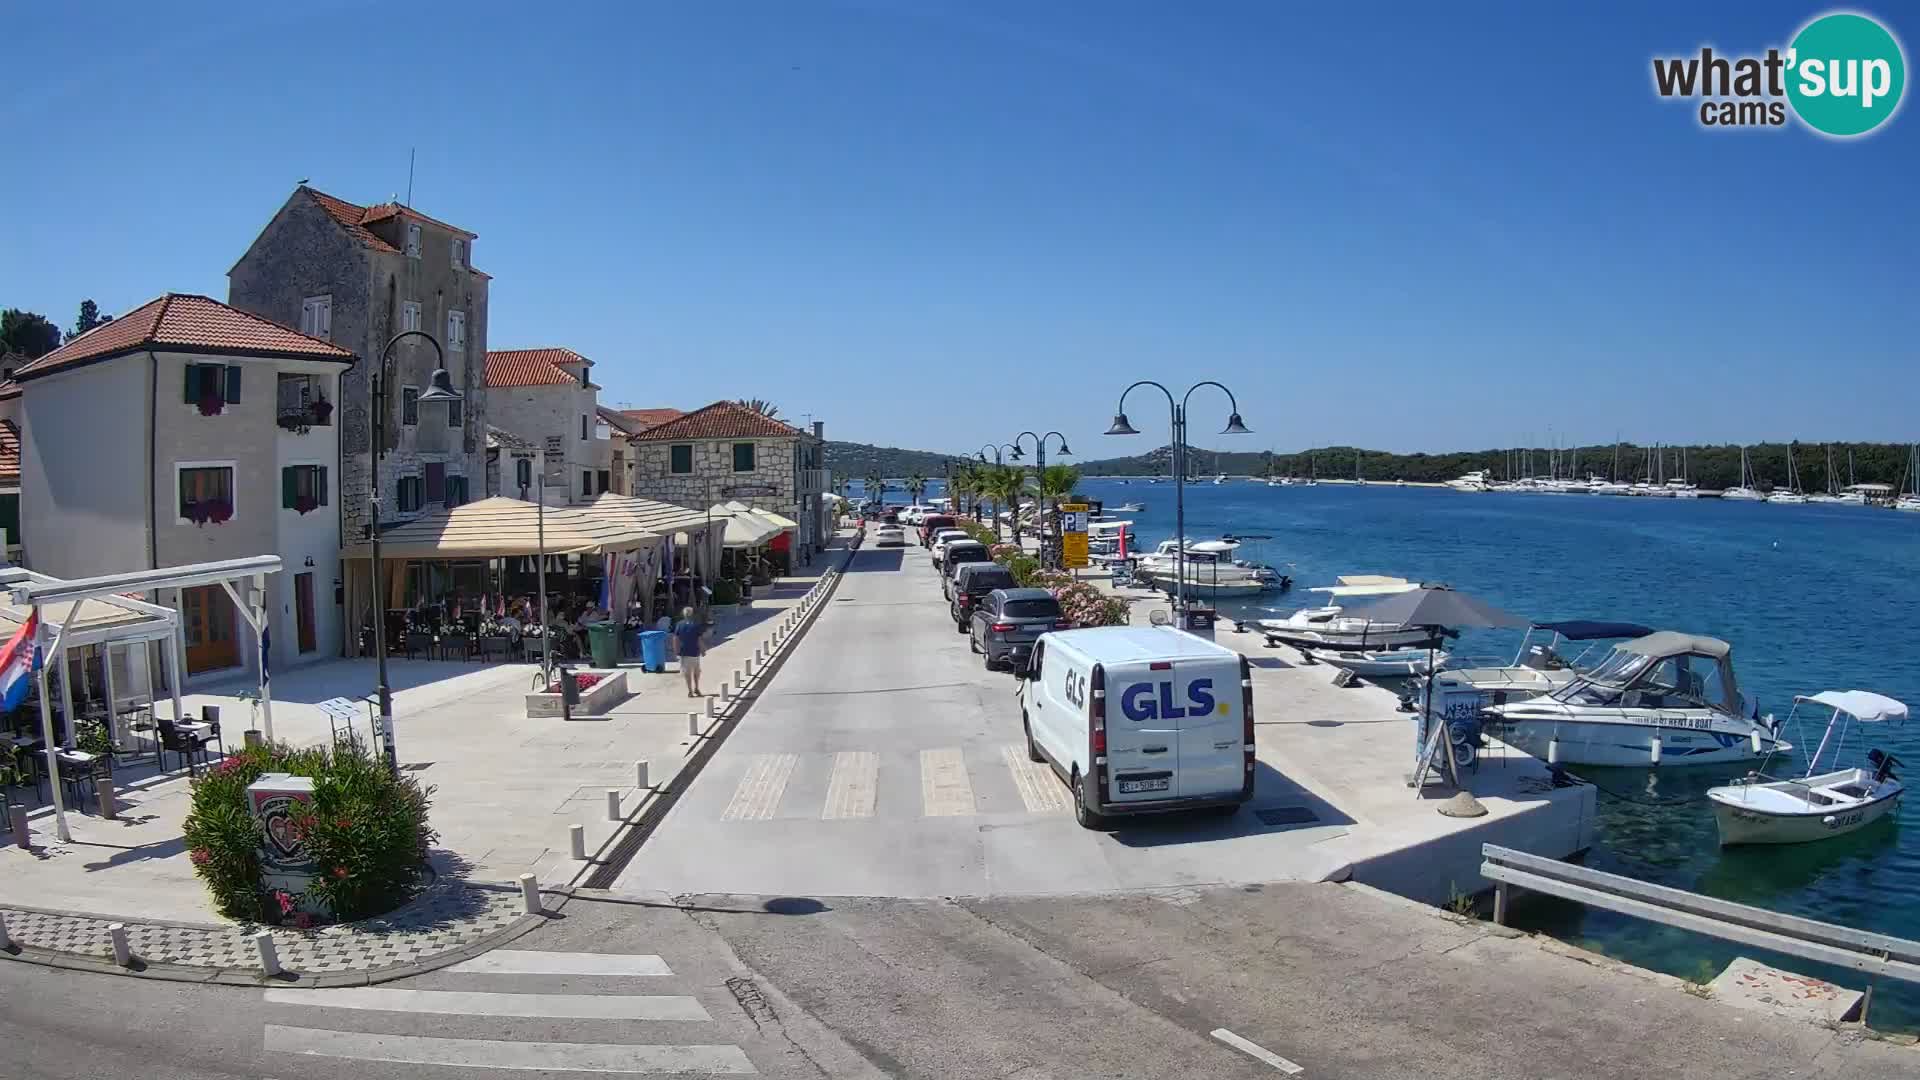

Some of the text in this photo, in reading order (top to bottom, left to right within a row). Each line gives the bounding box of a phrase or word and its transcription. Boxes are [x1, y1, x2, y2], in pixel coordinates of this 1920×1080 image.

[1065, 514, 1075, 529] P
[1065, 668, 1086, 710] GLS
[1121, 678, 1216, 722] GLS
[1668, 717, 1687, 728] RENT
[1688, 718, 1694, 728] A
[1695, 718, 1713, 729] BOAT
